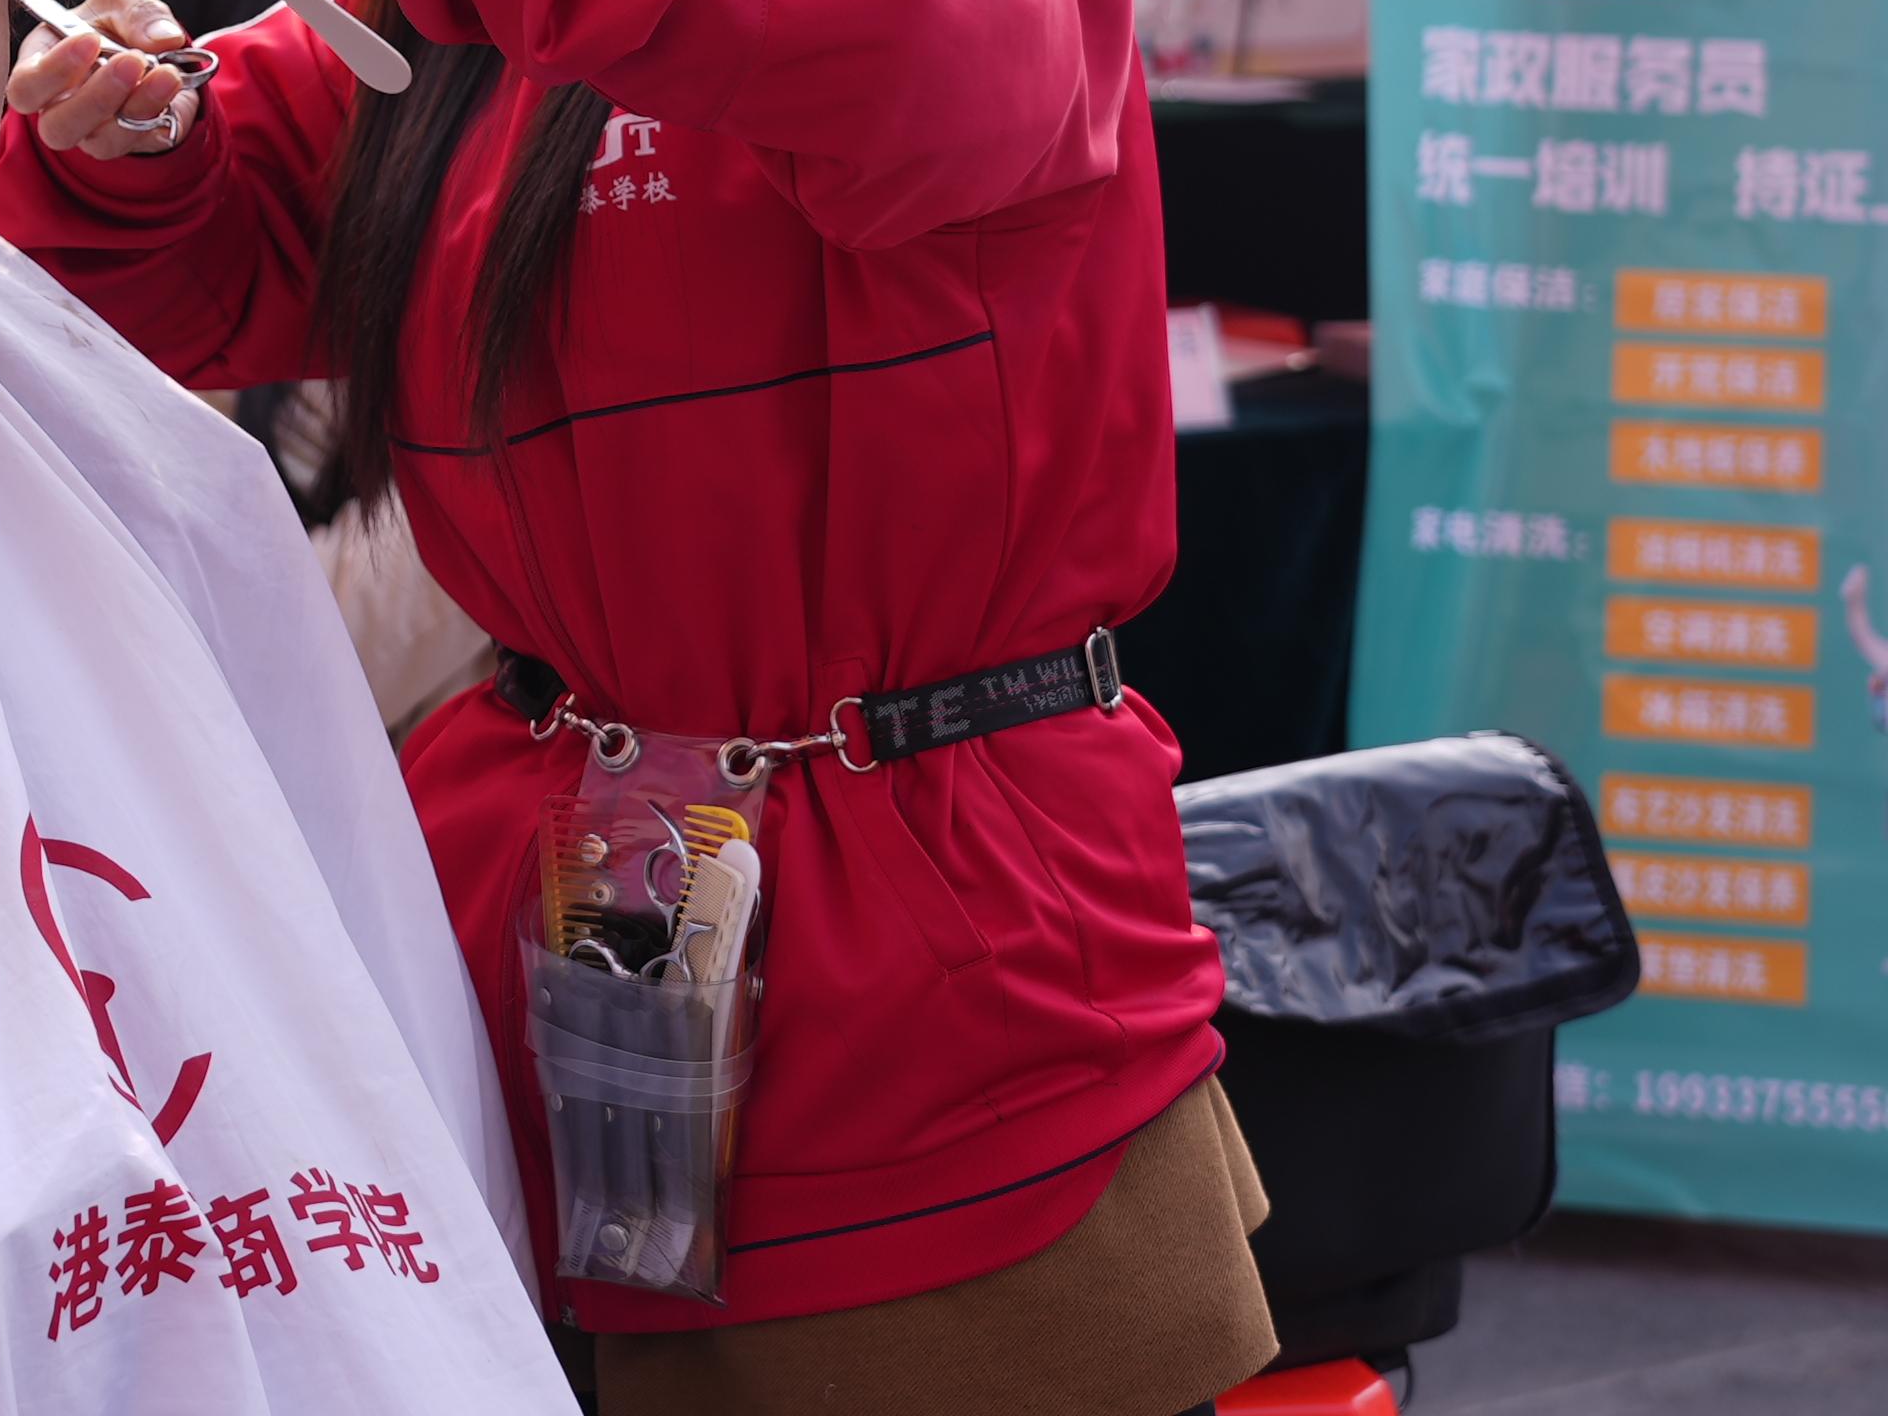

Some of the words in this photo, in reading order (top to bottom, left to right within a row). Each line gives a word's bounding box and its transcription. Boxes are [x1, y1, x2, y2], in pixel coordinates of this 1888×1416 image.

[1422, 26, 1767, 118] 家政服务员
[1417, 130, 1669, 216] 统一培训
[1734, 145, 1888, 225] 持证
[1635, 1069, 1888, 1132] 1993375555
[47, 1167, 440, 1342] 港泰商学院
